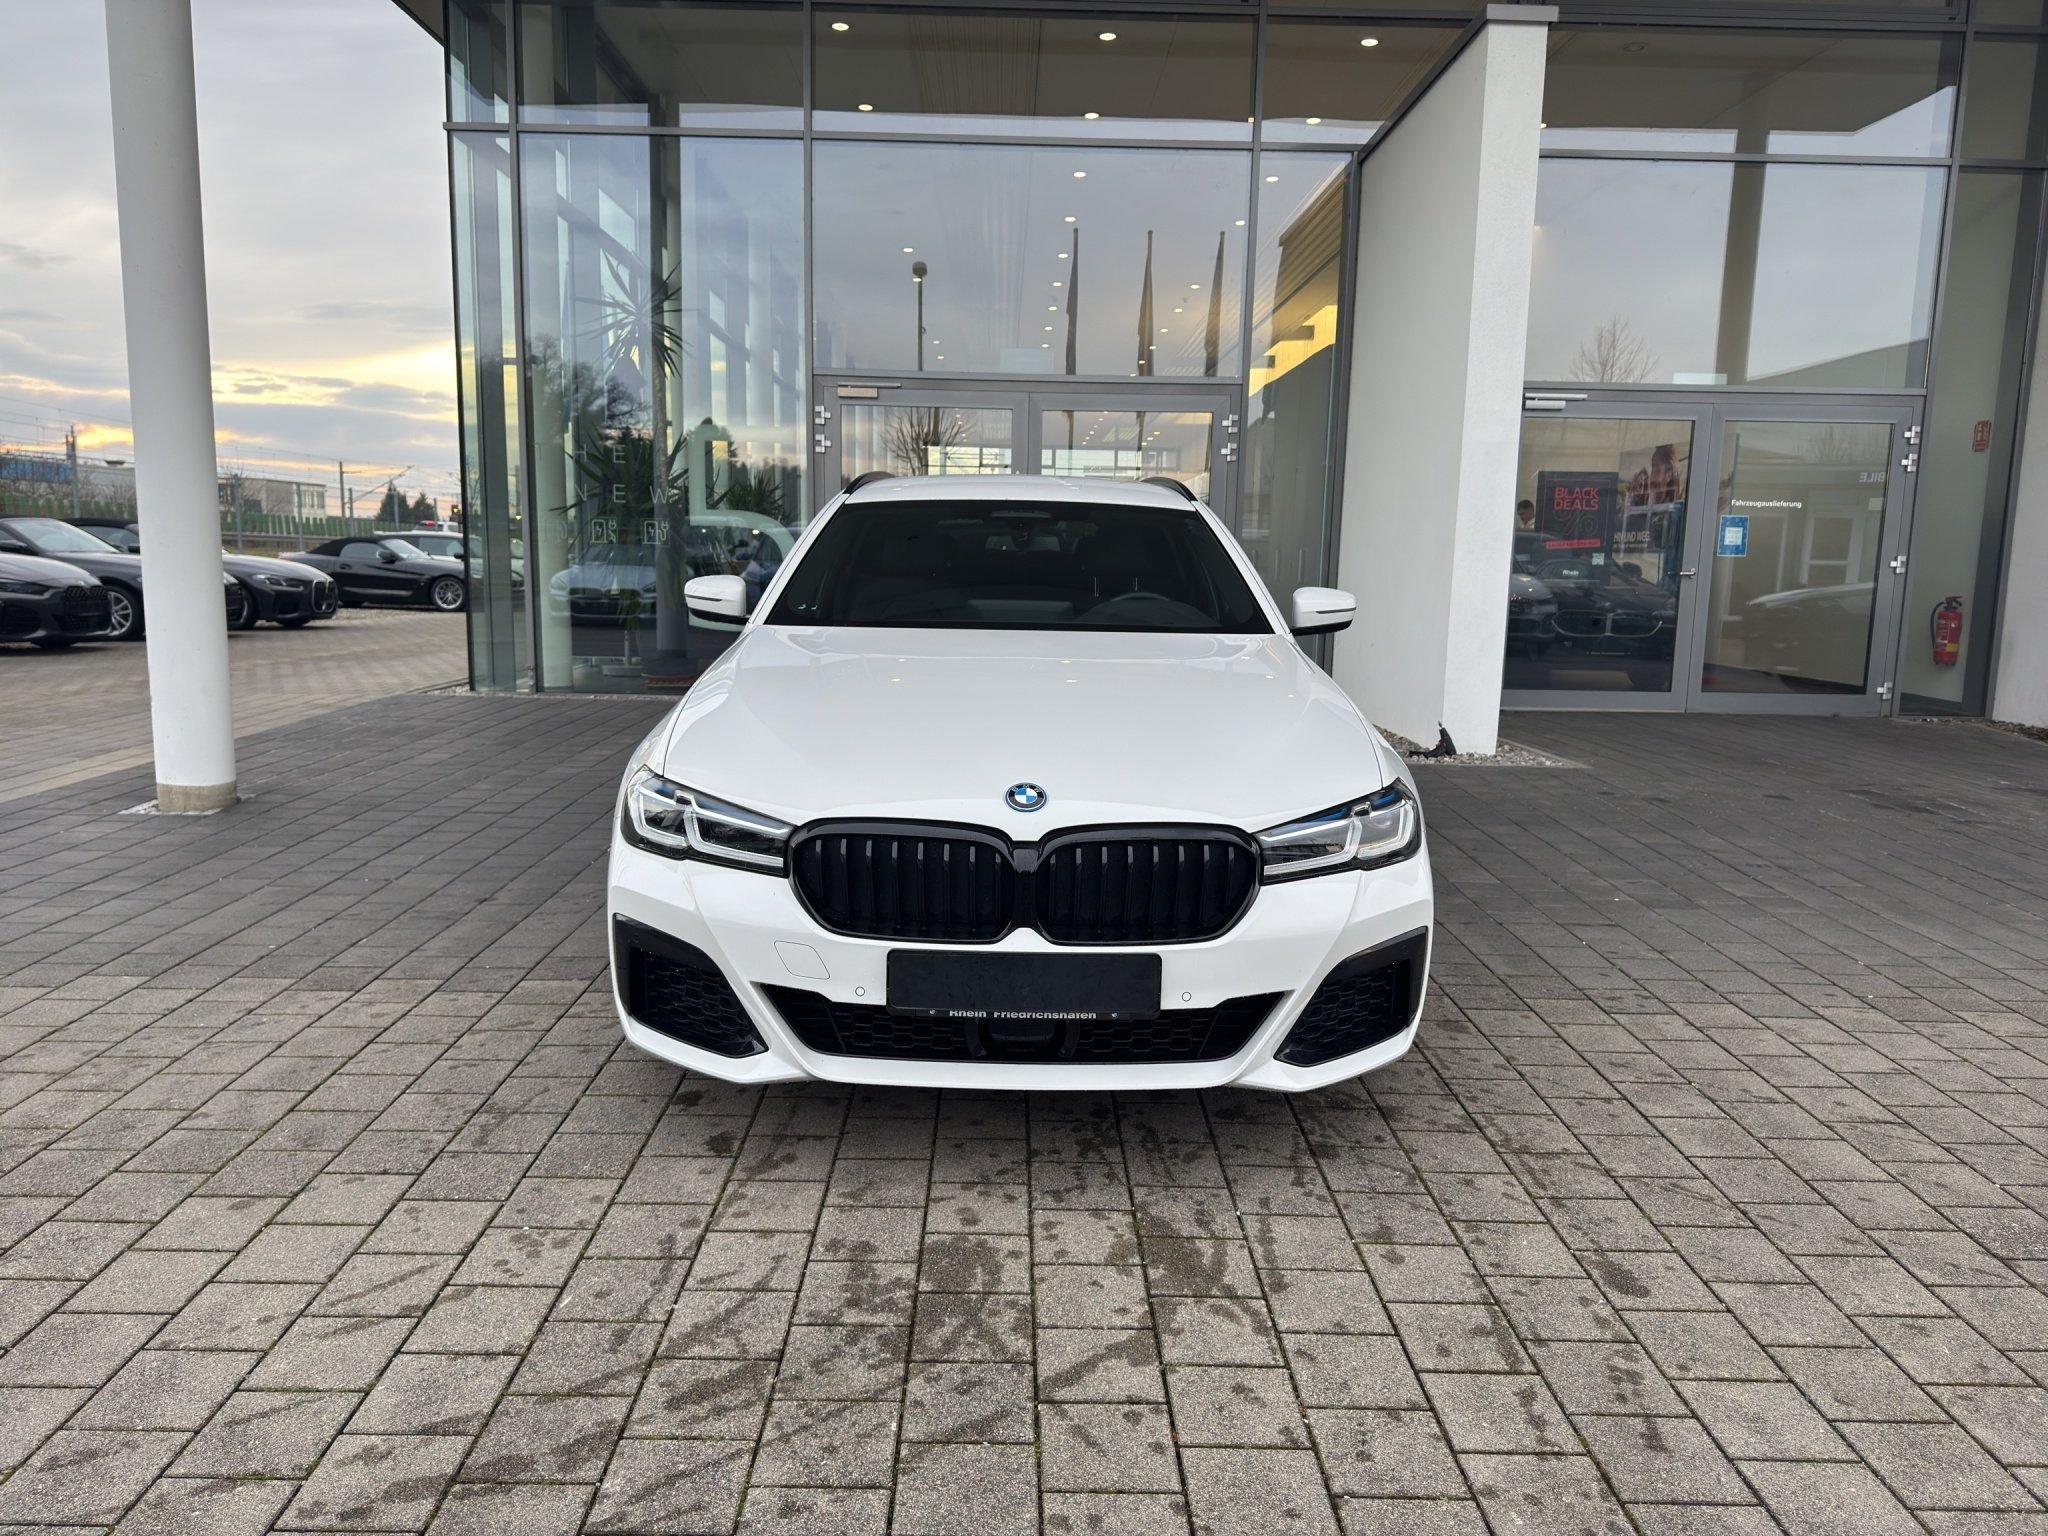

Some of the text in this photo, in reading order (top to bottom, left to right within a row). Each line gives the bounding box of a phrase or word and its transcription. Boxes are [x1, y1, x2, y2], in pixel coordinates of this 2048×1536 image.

[1555, 487, 1599, 499] BLACK
[1554, 498, 1599, 510] DEALS
[1731, 499, 1802, 509] Fahrzeugauslieferung
